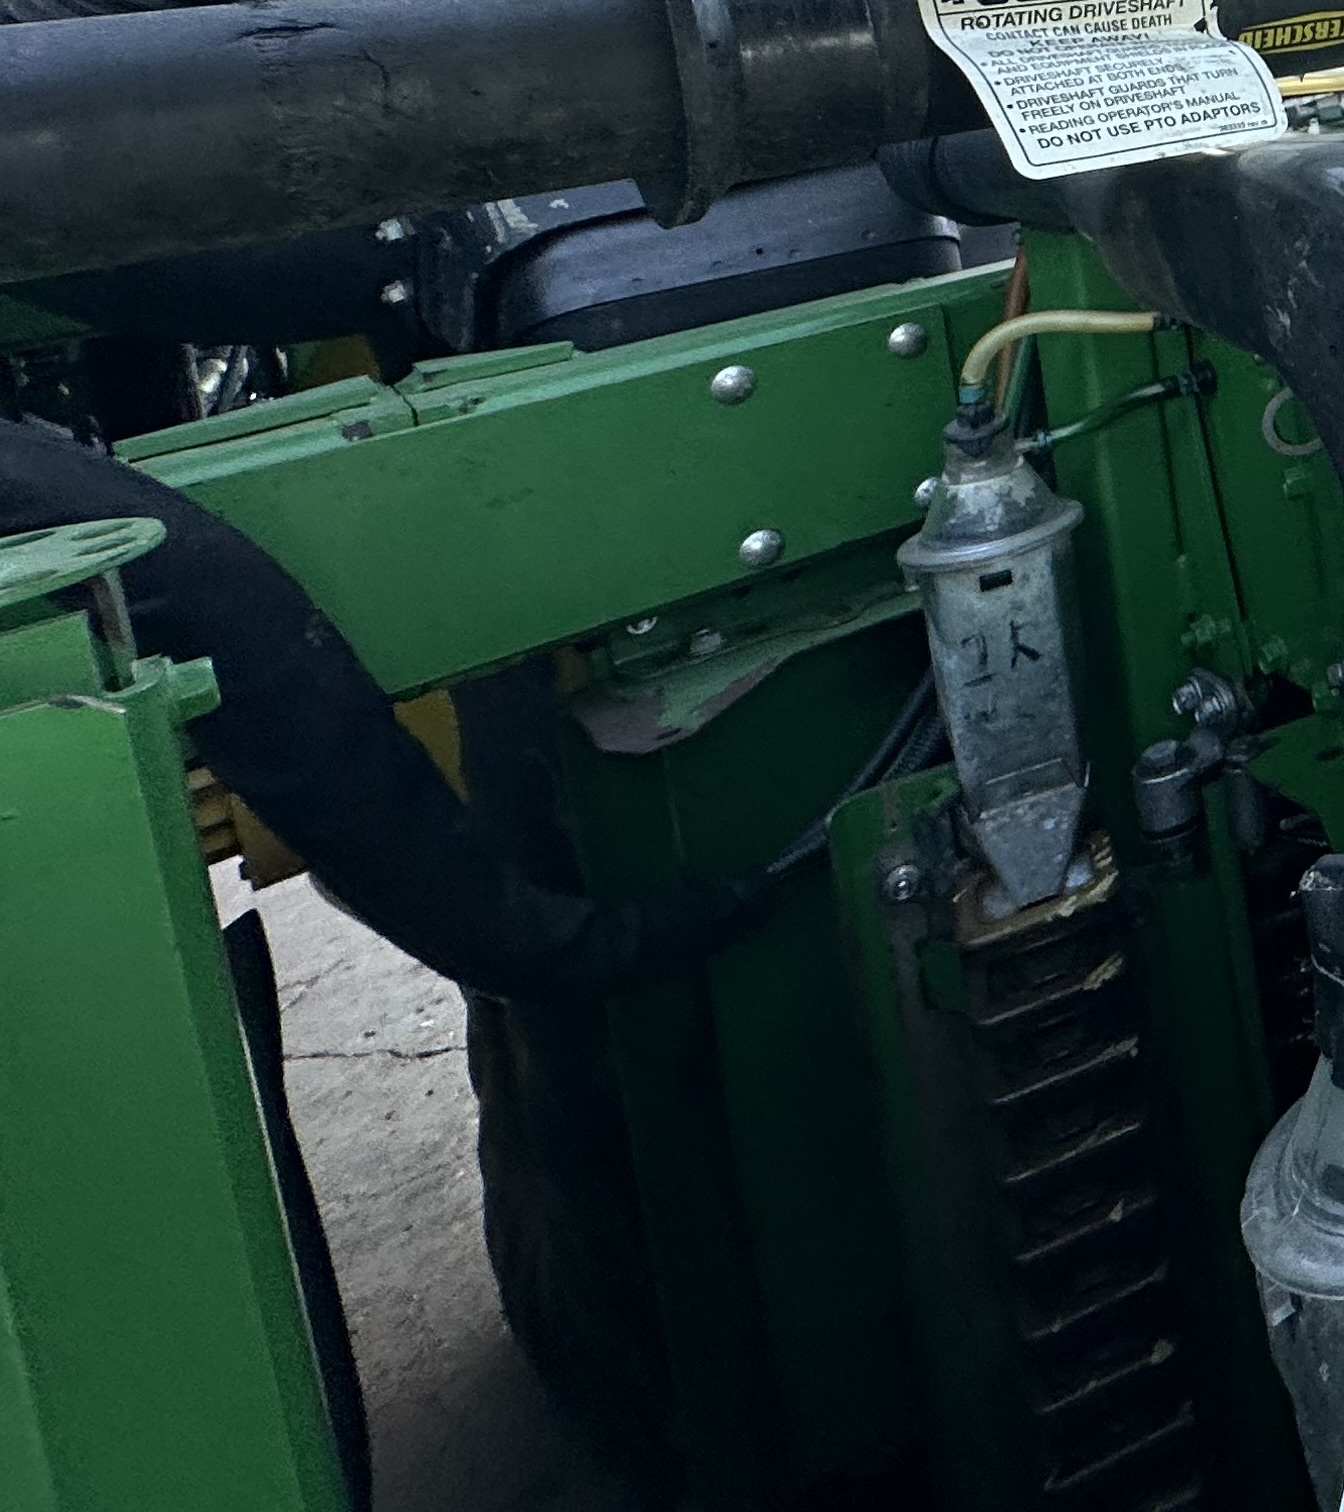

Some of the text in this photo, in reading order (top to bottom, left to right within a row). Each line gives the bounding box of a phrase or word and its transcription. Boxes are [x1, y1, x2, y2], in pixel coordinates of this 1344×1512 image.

[961, 7, 1062, 31] ROTATING
[986, 14, 1172, 41] CONTACT CAN CAUSE DEATH
[1003, 66, 1091, 87] DRIVESHAFT
[1010, 78, 1085, 97] ATTACHED
[1088, 74, 1104, 85] AT
[1107, 67, 1146, 82] BOTH
[1016, 68, 1239, 110] DRIVESHAFT GUARDS THAT TURN
[1021, 86, 1186, 121] FREELY ON DRIVESHAFT
[1028, 91, 1241, 135] READING OPERATOR'S MANUAL
[1037, 101, 1261, 149] DO NOT USE PTO ADAPTORS
